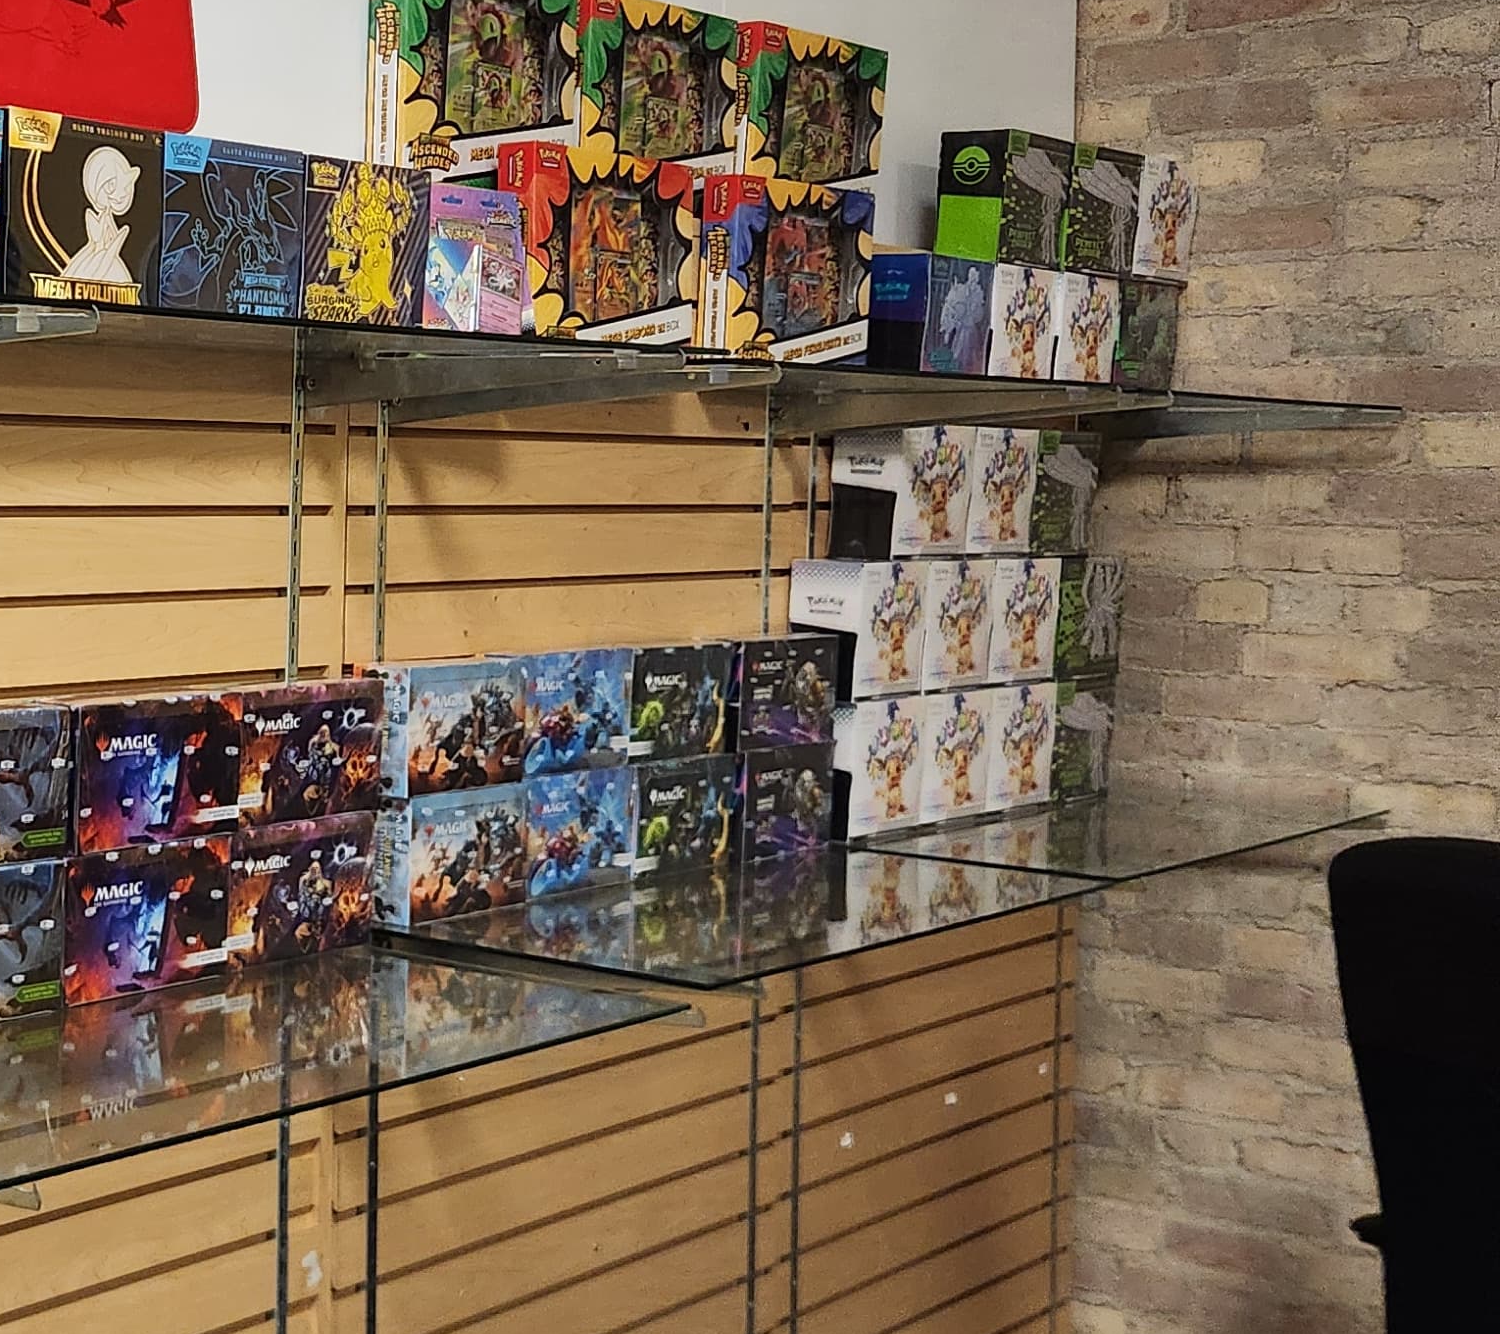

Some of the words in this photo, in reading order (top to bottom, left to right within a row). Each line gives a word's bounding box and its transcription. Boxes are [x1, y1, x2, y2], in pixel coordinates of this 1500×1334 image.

[410, 139, 459, 166] ASCENDED
[414, 154, 451, 172] HEROES
[36, 278, 73, 300] MEGA
[74, 283, 137, 305] EVOLUTION
[233, 289, 290, 305] PHANTASMAL
[306, 295, 353, 306] SURGING
[263, 716, 302, 732] MAGIC
[109, 733, 158, 752] MAGIC
[253, 855, 292, 872] MAGIC
[93, 880, 144, 902] MAGIC
